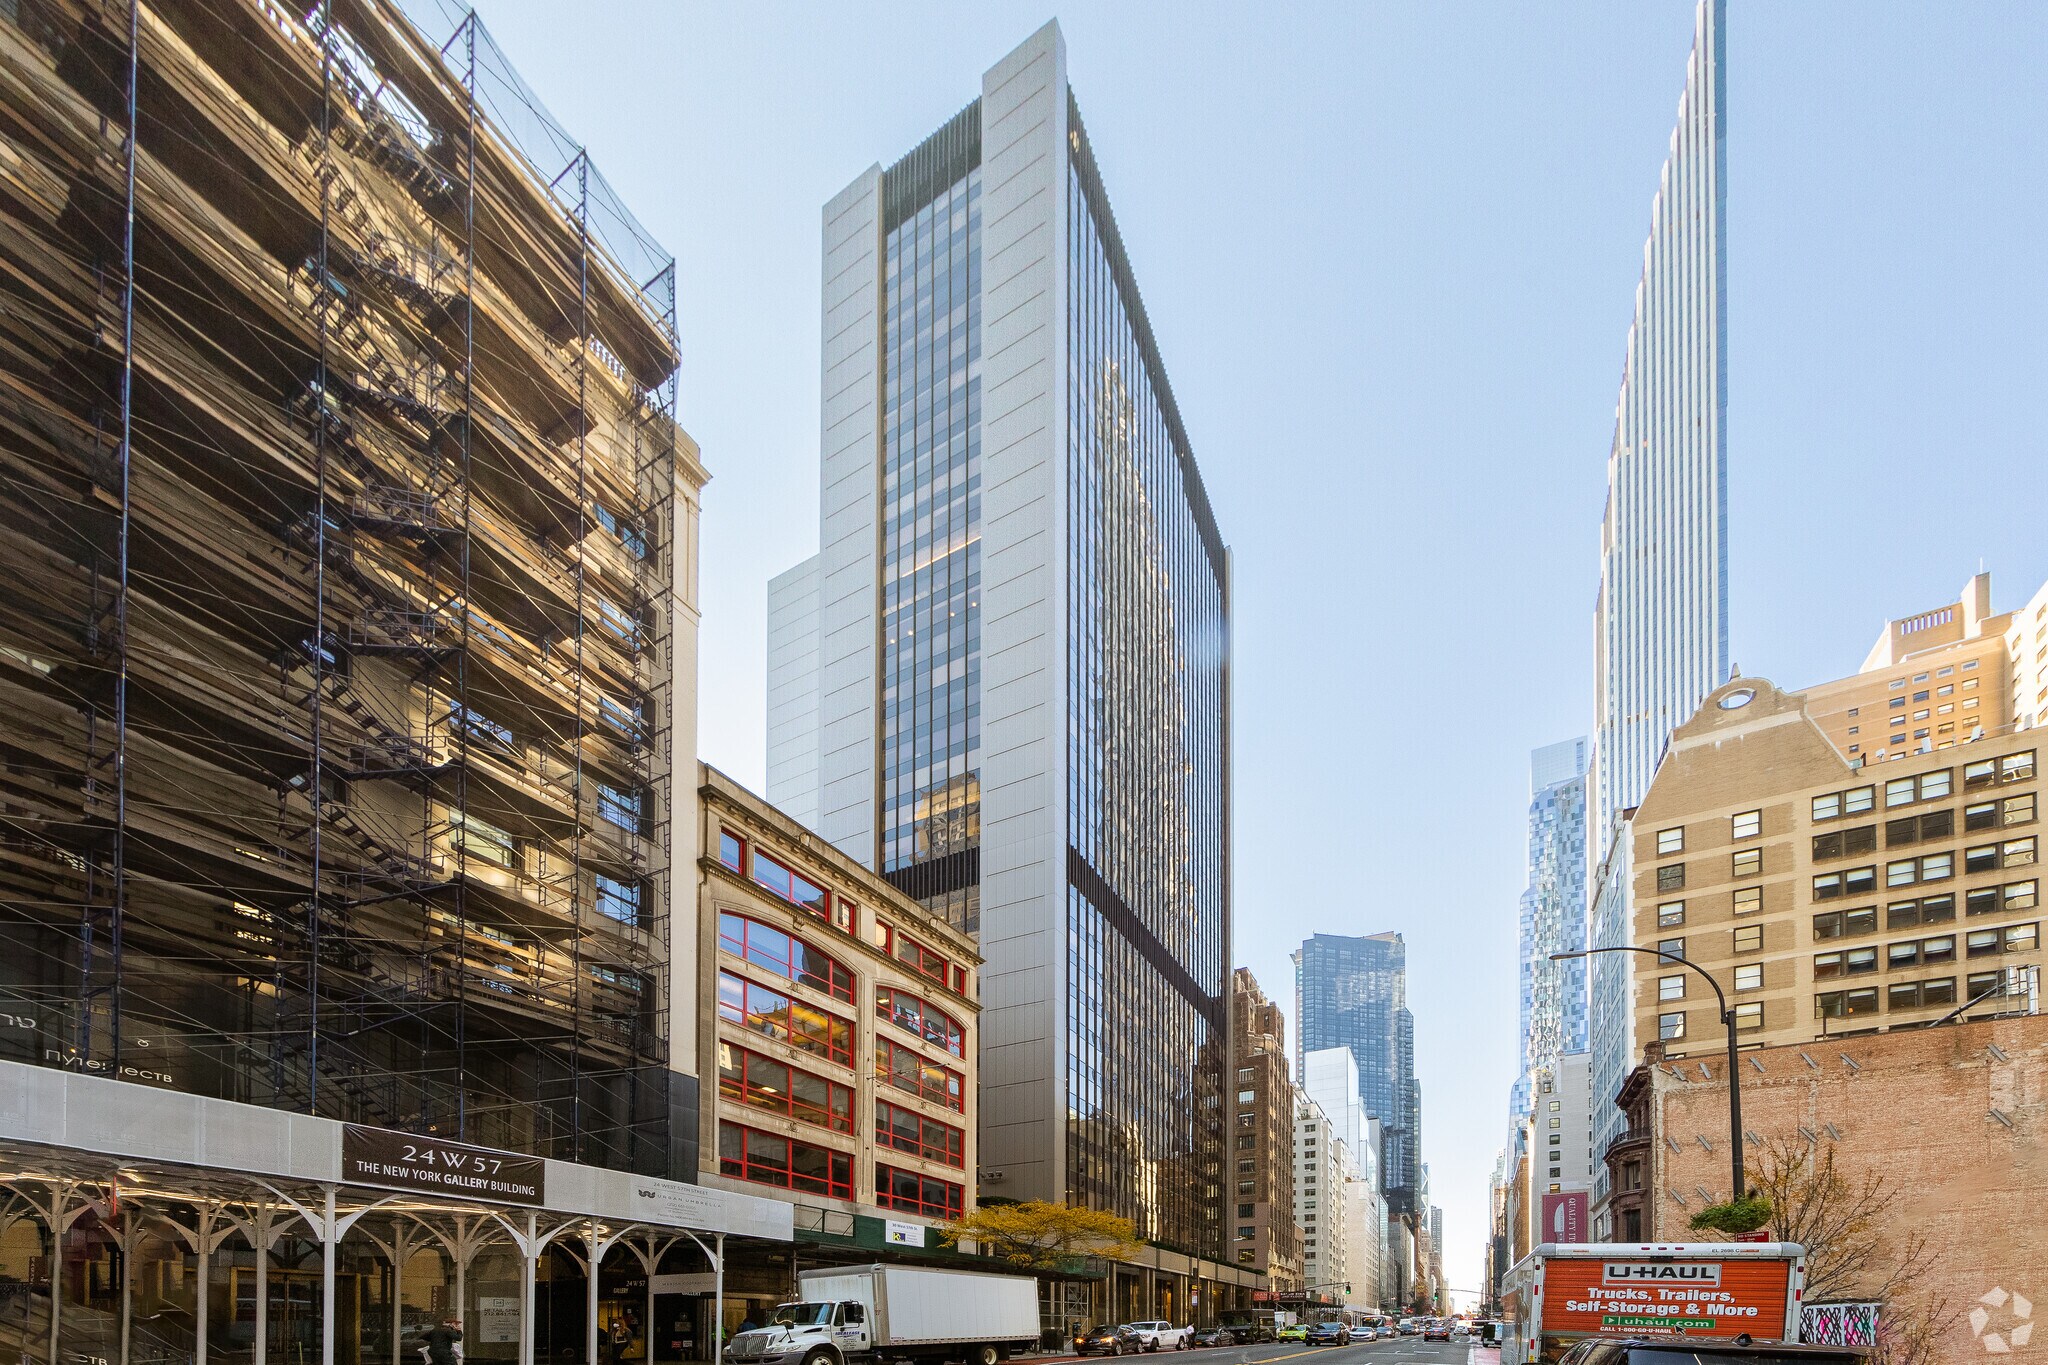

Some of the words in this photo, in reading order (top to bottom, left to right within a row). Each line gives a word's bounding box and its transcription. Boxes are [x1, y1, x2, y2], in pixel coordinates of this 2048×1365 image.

[401, 1145, 436, 1165] 24
[440, 1151, 468, 1169] W
[473, 1157, 502, 1175] 57
[356, 1160, 380, 1174] THE
[383, 1164, 409, 1178] NEW
[412, 1168, 441, 1183] YORK
[443, 1174, 489, 1189] GALLERY
[490, 1180, 535, 1196] BUILDING
[1568, 1197, 1577, 1231] QUALITY
[1568, 1233, 1577, 1244] IT
[1608, 1266, 1715, 1279] U-HAUL
[1587, 1287, 1652, 1302] Trucks,
[1658, 1289, 1736, 1303] Trailers,
[1565, 1300, 1680, 1316] Self-Storage
[1685, 1304, 1701, 1315] &
[1706, 1304, 1759, 1317] More
[1624, 1317, 1710, 1328] uhaul.com
